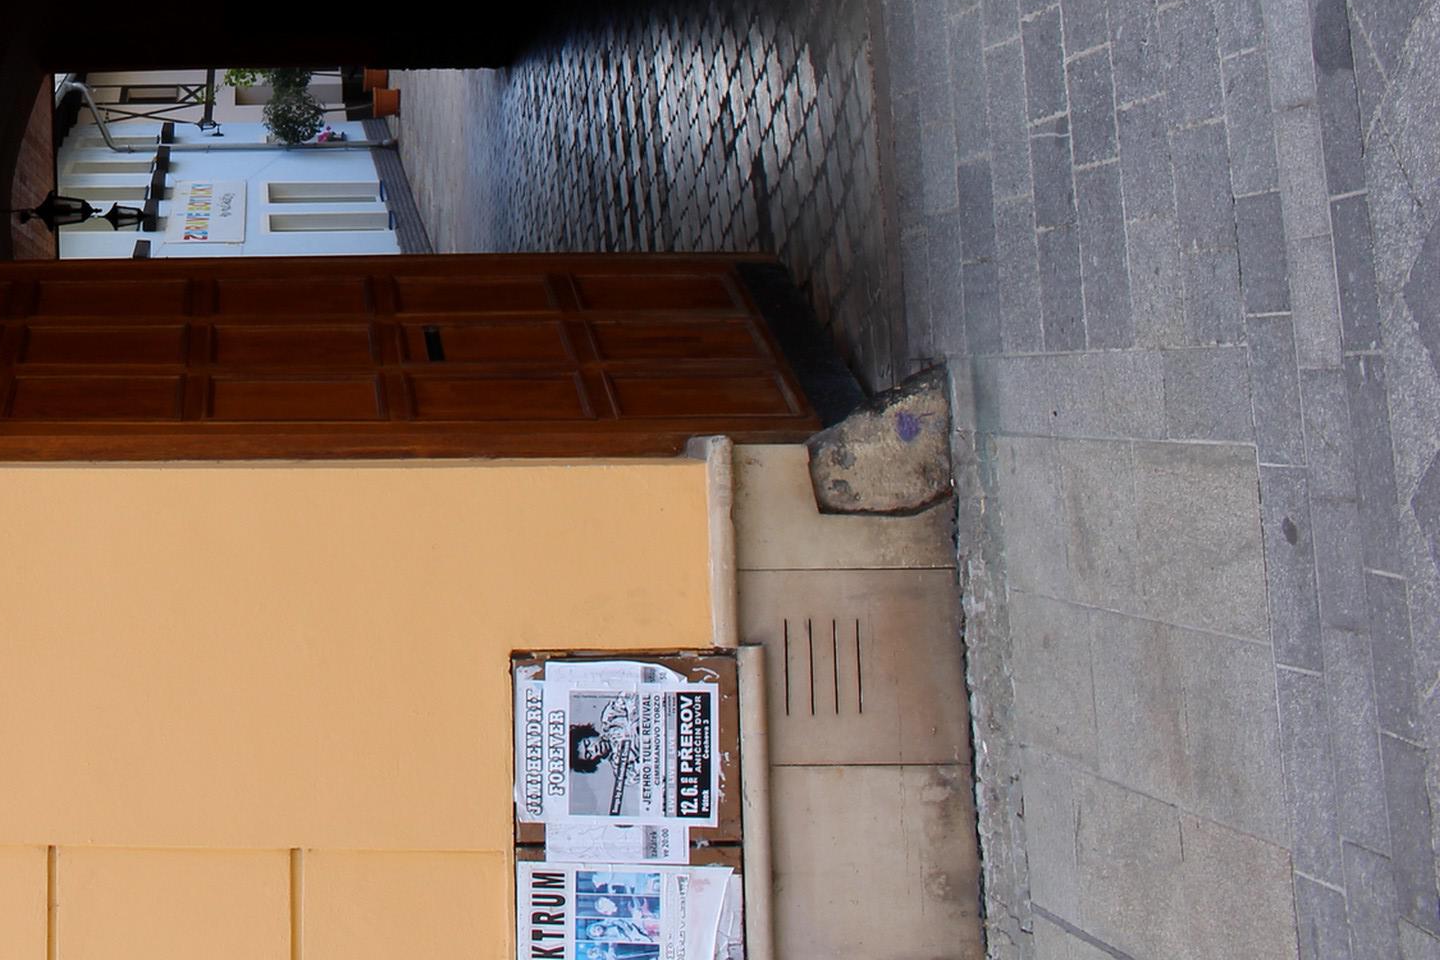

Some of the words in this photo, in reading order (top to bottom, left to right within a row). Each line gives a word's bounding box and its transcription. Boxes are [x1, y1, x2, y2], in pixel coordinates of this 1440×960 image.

[642, 694, 651, 736] REVIVAL
[678, 696, 693, 772] PŘEROV
[548, 710, 565, 796] FOREVER
[642, 739, 651, 762] TULL
[702, 726, 710, 759] Čechova
[526, 774, 542, 815] JIMI
[642, 766, 652, 805] JETHRO
[662, 850, 669, 858] ve
[531, 872, 565, 960] KTRUM
